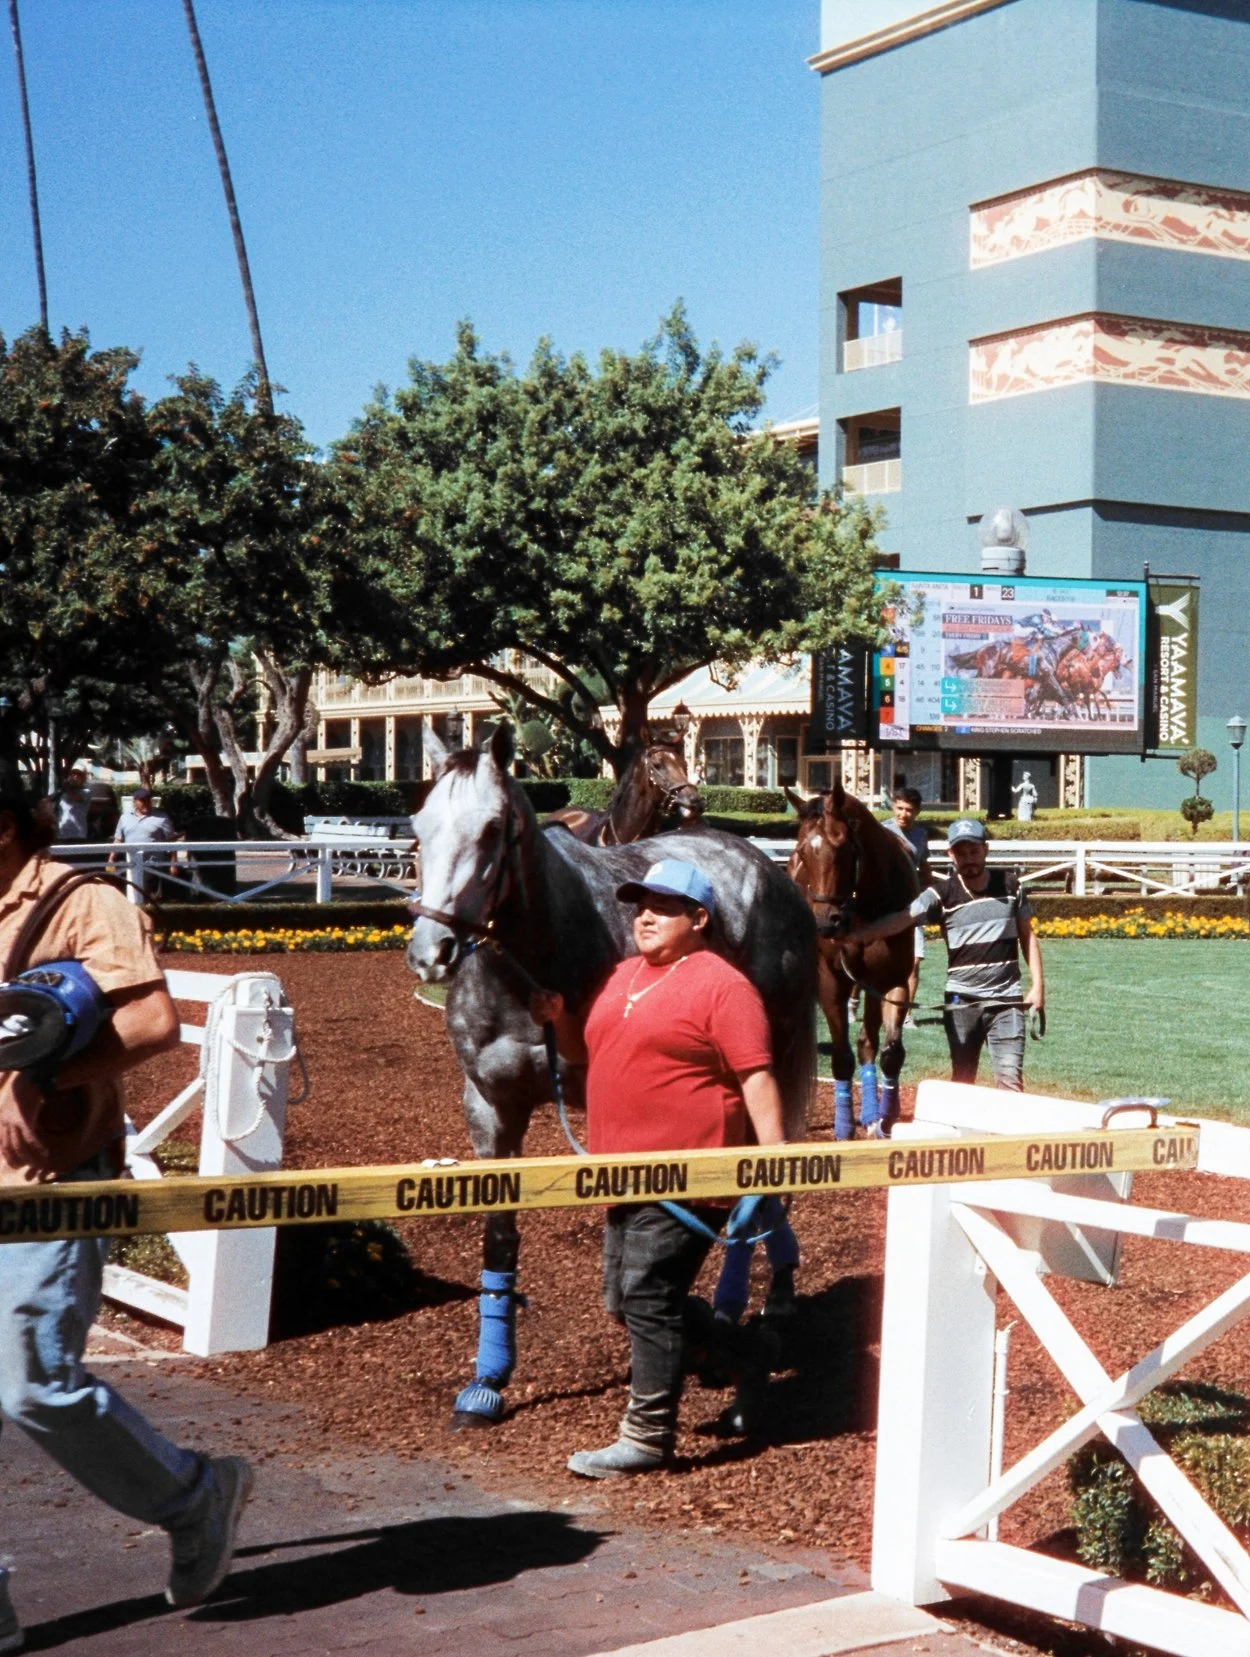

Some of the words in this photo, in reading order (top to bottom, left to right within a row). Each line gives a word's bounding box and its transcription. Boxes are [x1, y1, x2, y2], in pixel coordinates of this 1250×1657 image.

[1002, 587, 1014, 599] 23
[945, 614, 970, 623] FREE
[972, 615, 1012, 625] FRIDAYS
[1160, 636, 1170, 683] RESORT
[825, 685, 835, 730] CASINO
[1160, 685, 1169, 693] &
[1159, 696, 1169, 741] CASINO
[0, 1193, 139, 1235] CAUTION
[203, 1183, 338, 1222] CAUTION
[395, 1172, 521, 1211] CAUTION
[575, 1162, 688, 1199] CAUTION
[736, 1155, 841, 1188] CAUTION
[888, 1147, 985, 1179] CAUTION
[1025, 1141, 1113, 1171] CAUTION
